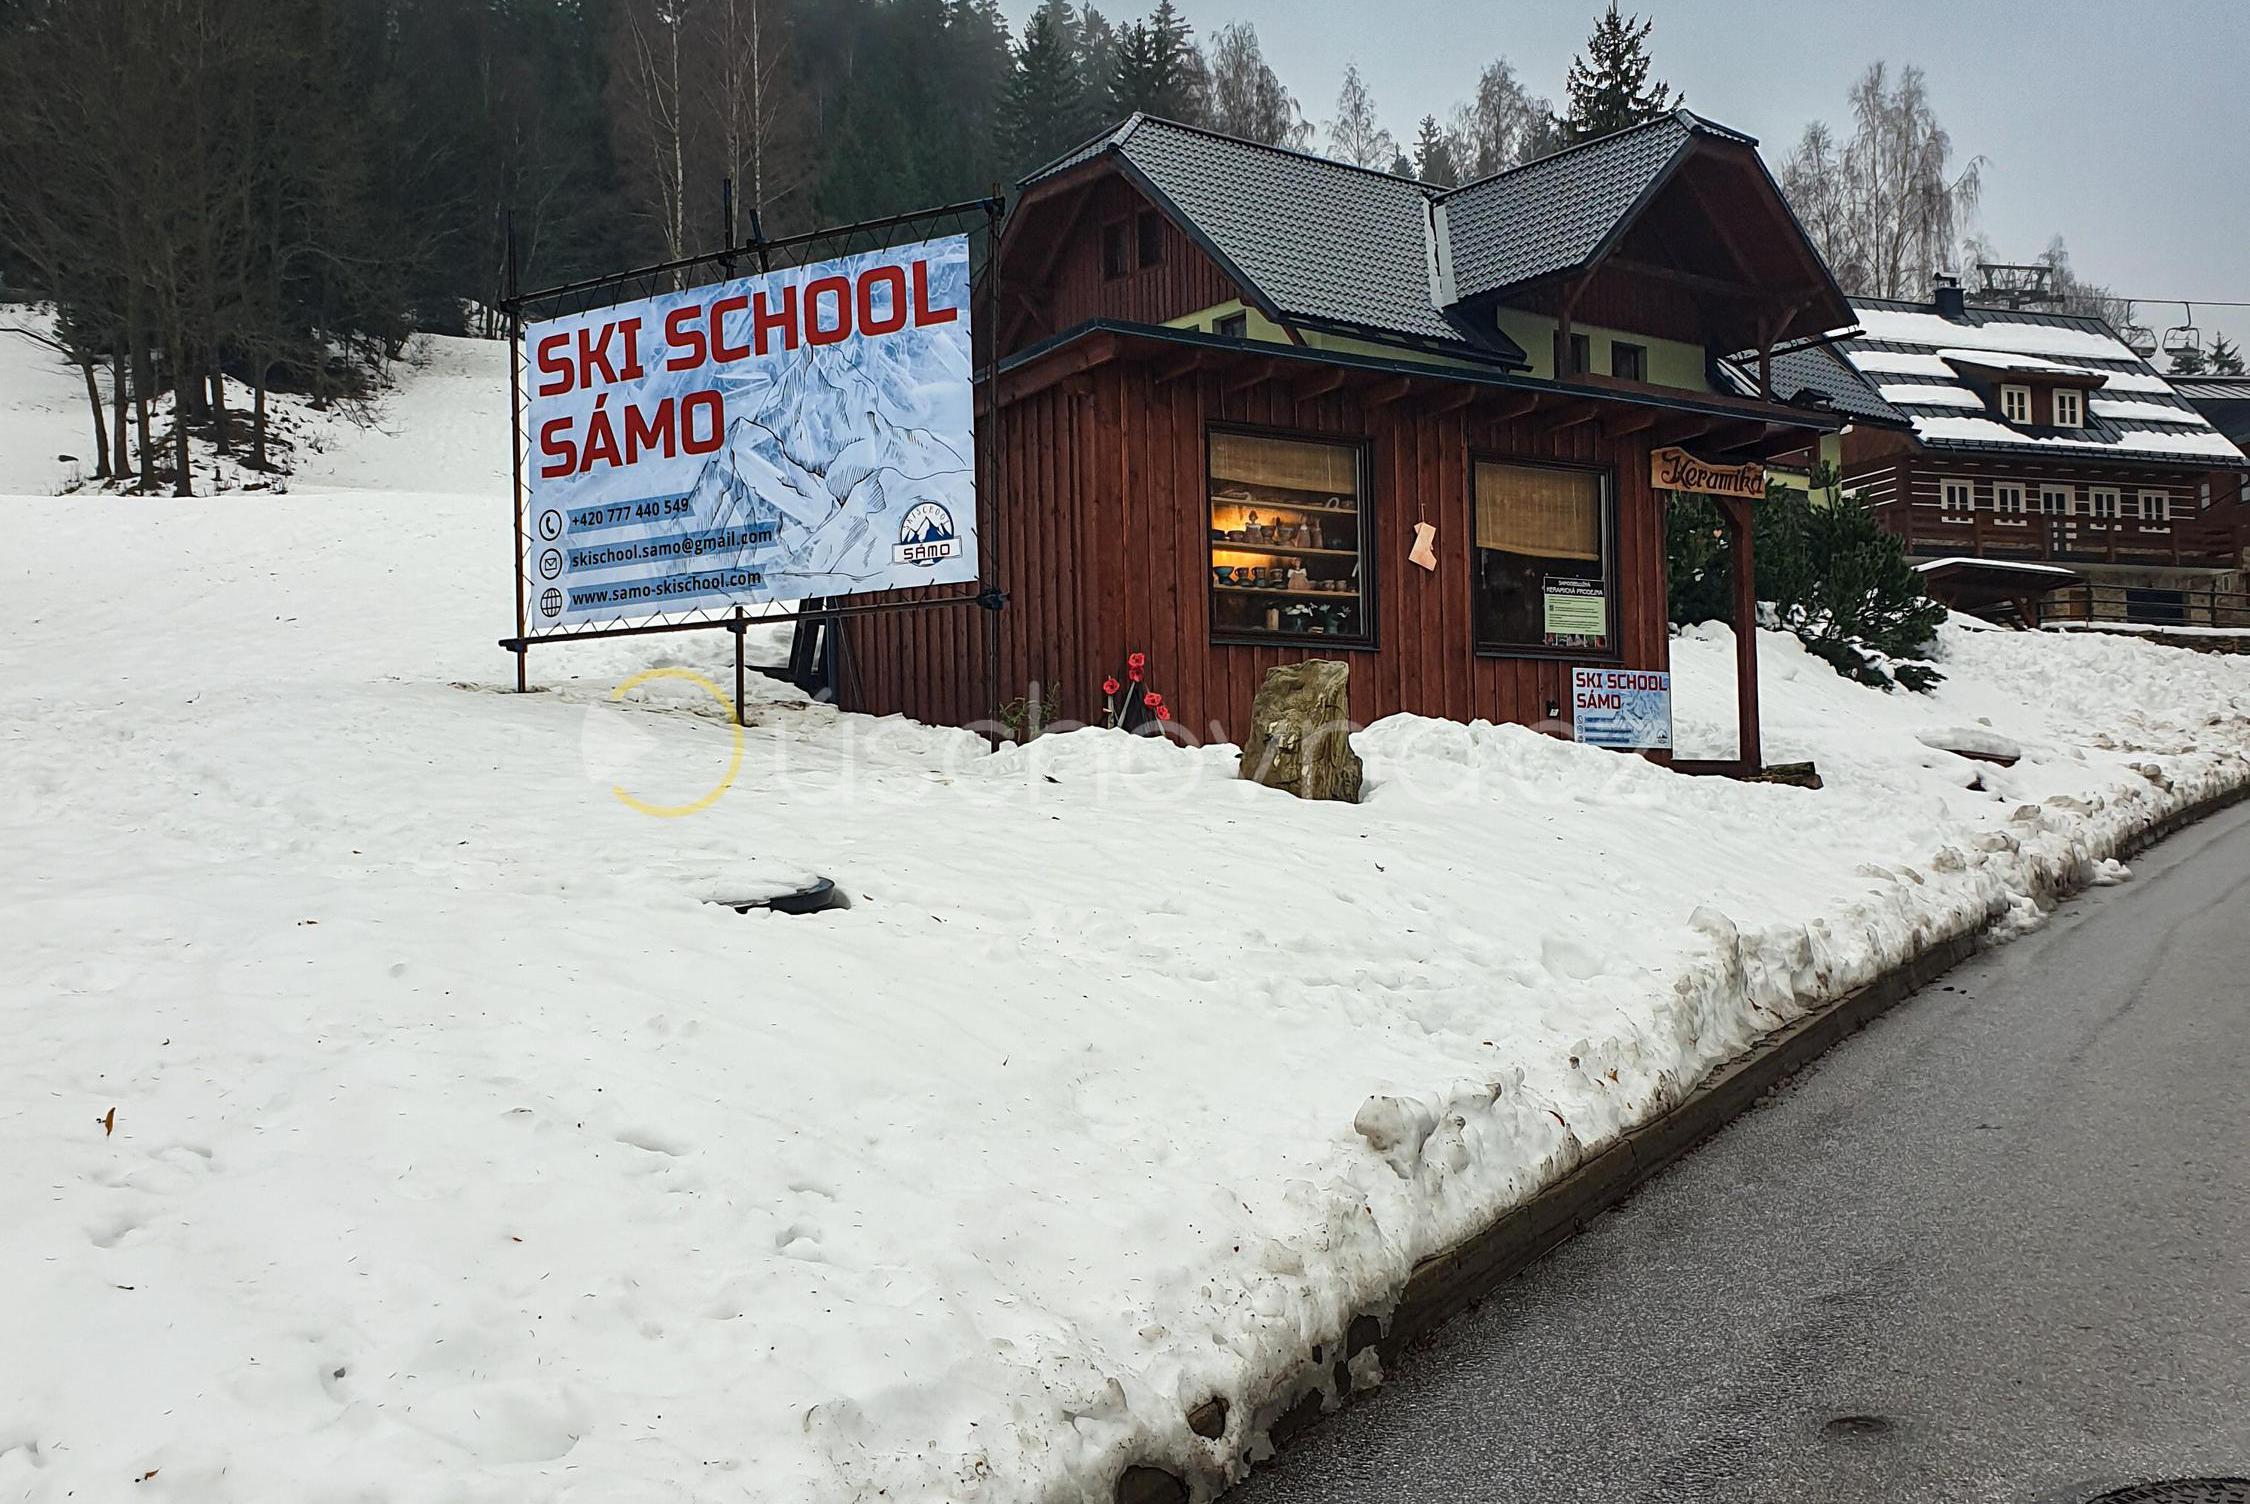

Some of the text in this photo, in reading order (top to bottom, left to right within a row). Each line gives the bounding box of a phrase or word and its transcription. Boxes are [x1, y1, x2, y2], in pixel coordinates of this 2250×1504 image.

[538, 260, 958, 397] SKI SCHOOL
[540, 390, 725, 478] SÁMO
[1661, 451, 1763, 496] Keramika
[572, 498, 689, 527] +420 777 440 549
[572, 528, 772, 567] skischool.samo@gmail.com
[903, 544, 950, 560] SÁMO
[572, 572, 761, 605] www.samo-skischool.com
[1576, 672, 1668, 691] SKI SCHOOL
[1576, 690, 1621, 709] SÁMO
